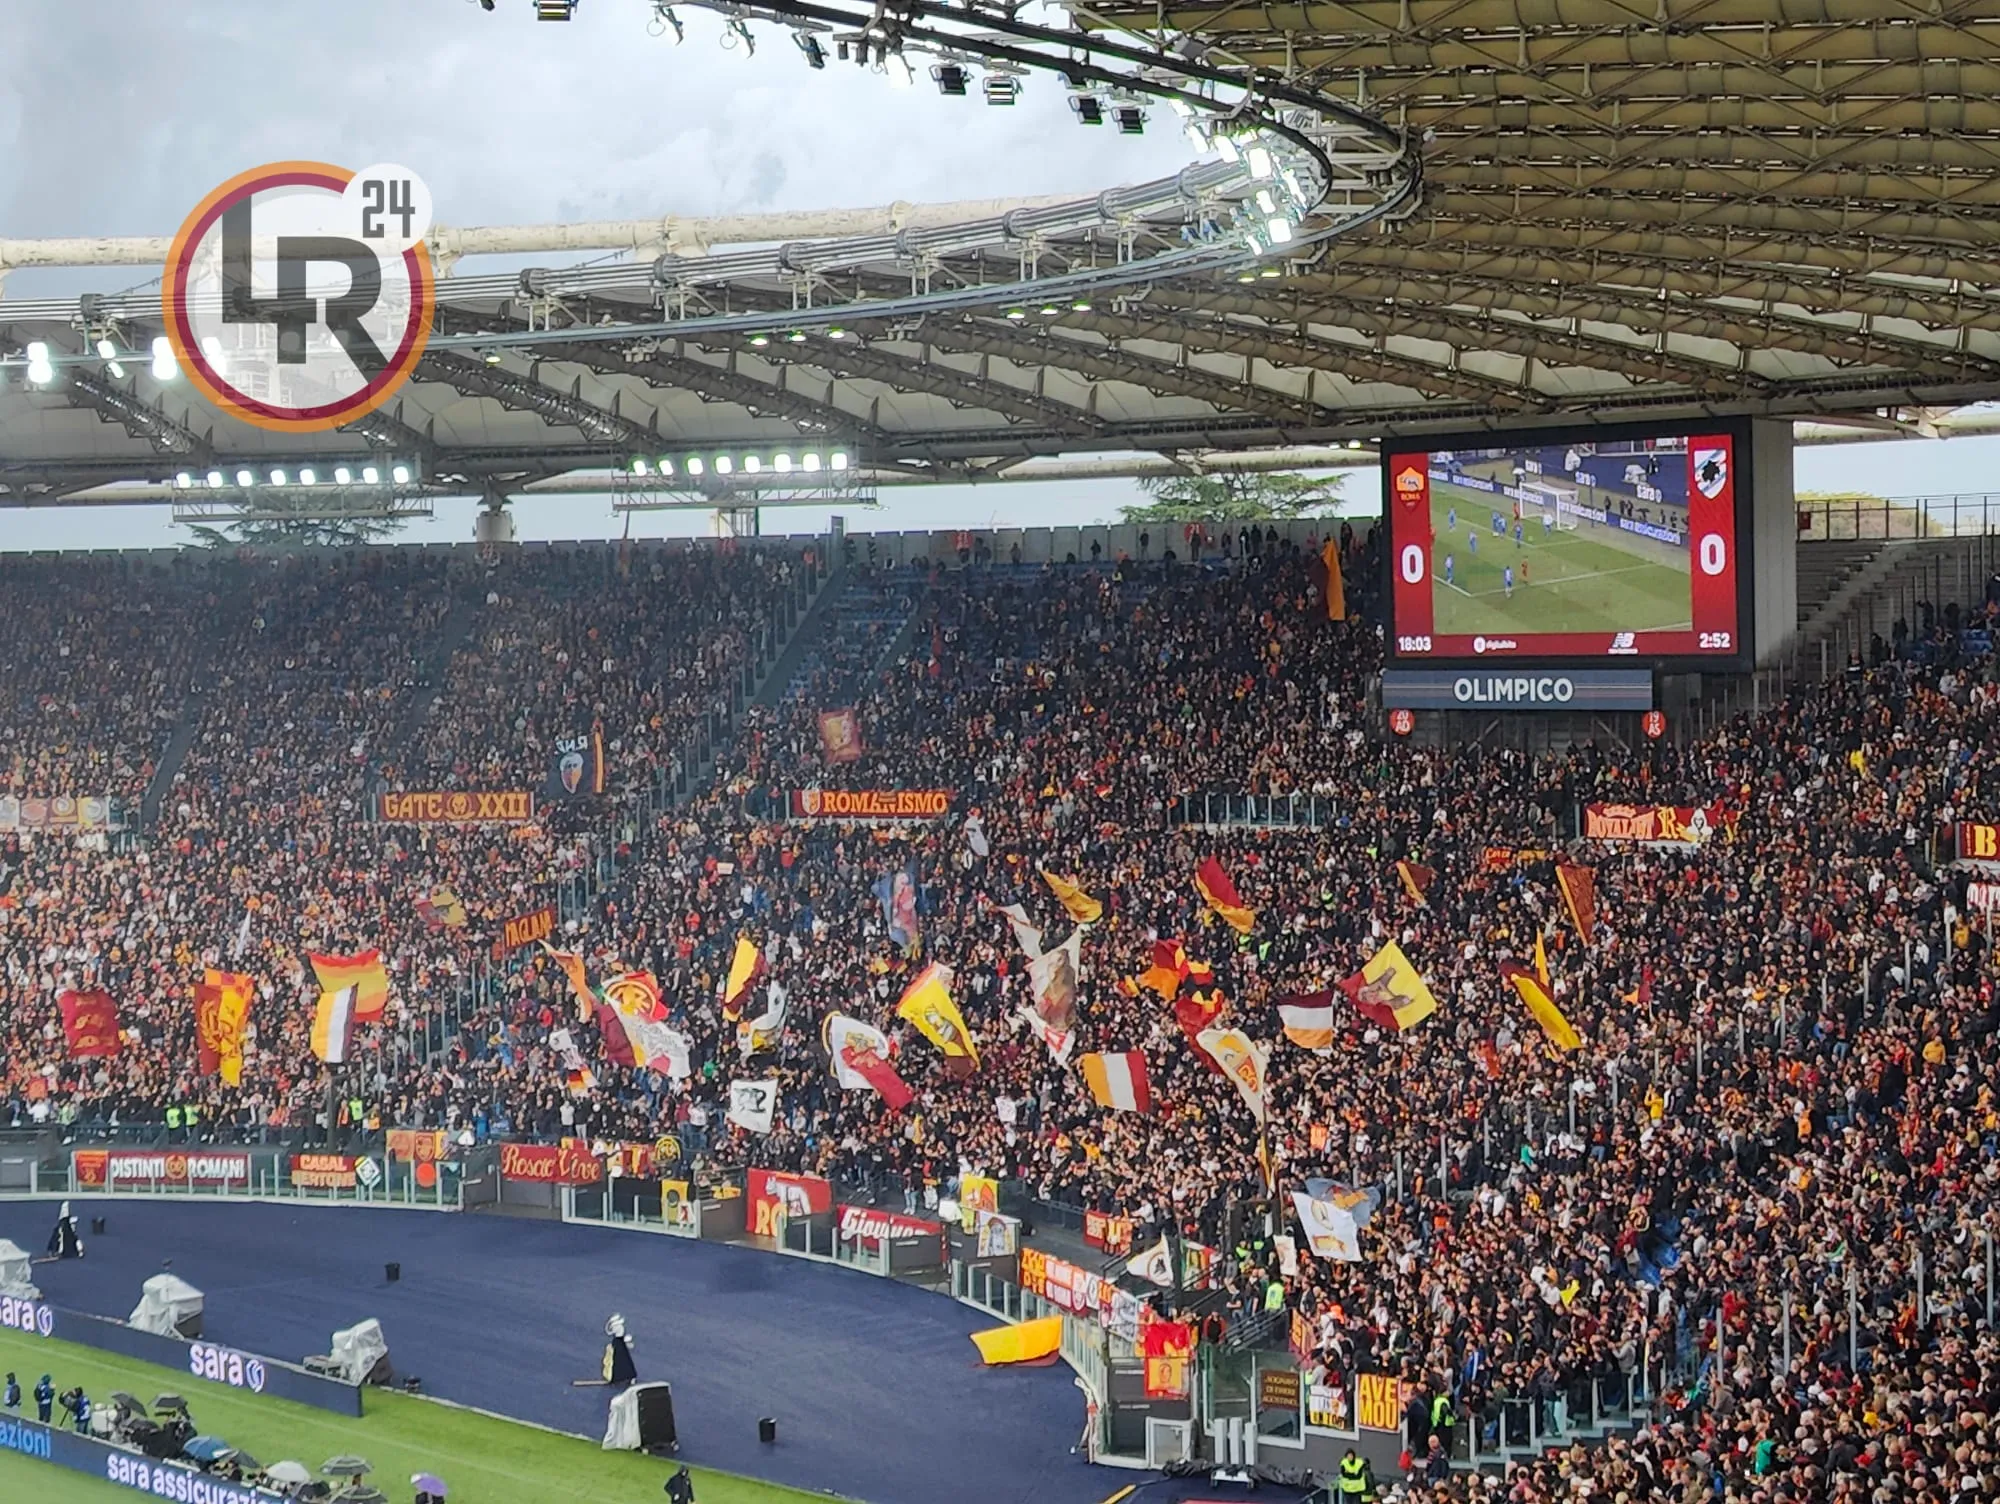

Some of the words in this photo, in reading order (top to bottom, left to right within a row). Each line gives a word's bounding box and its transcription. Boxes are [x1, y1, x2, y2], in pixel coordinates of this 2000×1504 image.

[1402, 545, 1424, 583] 0
[1701, 533, 1725, 575] 0
[1398, 636, 1431, 651] 18:03
[1699, 632, 1730, 648] 2:52
[1454, 677, 1574, 702] OLIMPICO
[384, 795, 443, 819] GATE
[477, 794, 529, 819] XXII
[822, 791, 948, 814] ROMANISMO
[110, 1157, 165, 1178] DISTINTI
[0, 1296, 35, 1333] ara
[189, 1343, 244, 1387] sara
[1359, 1374, 1398, 1402] AVE
[1358, 1399, 1397, 1430] MOU
[107, 1453, 149, 1491] sara
